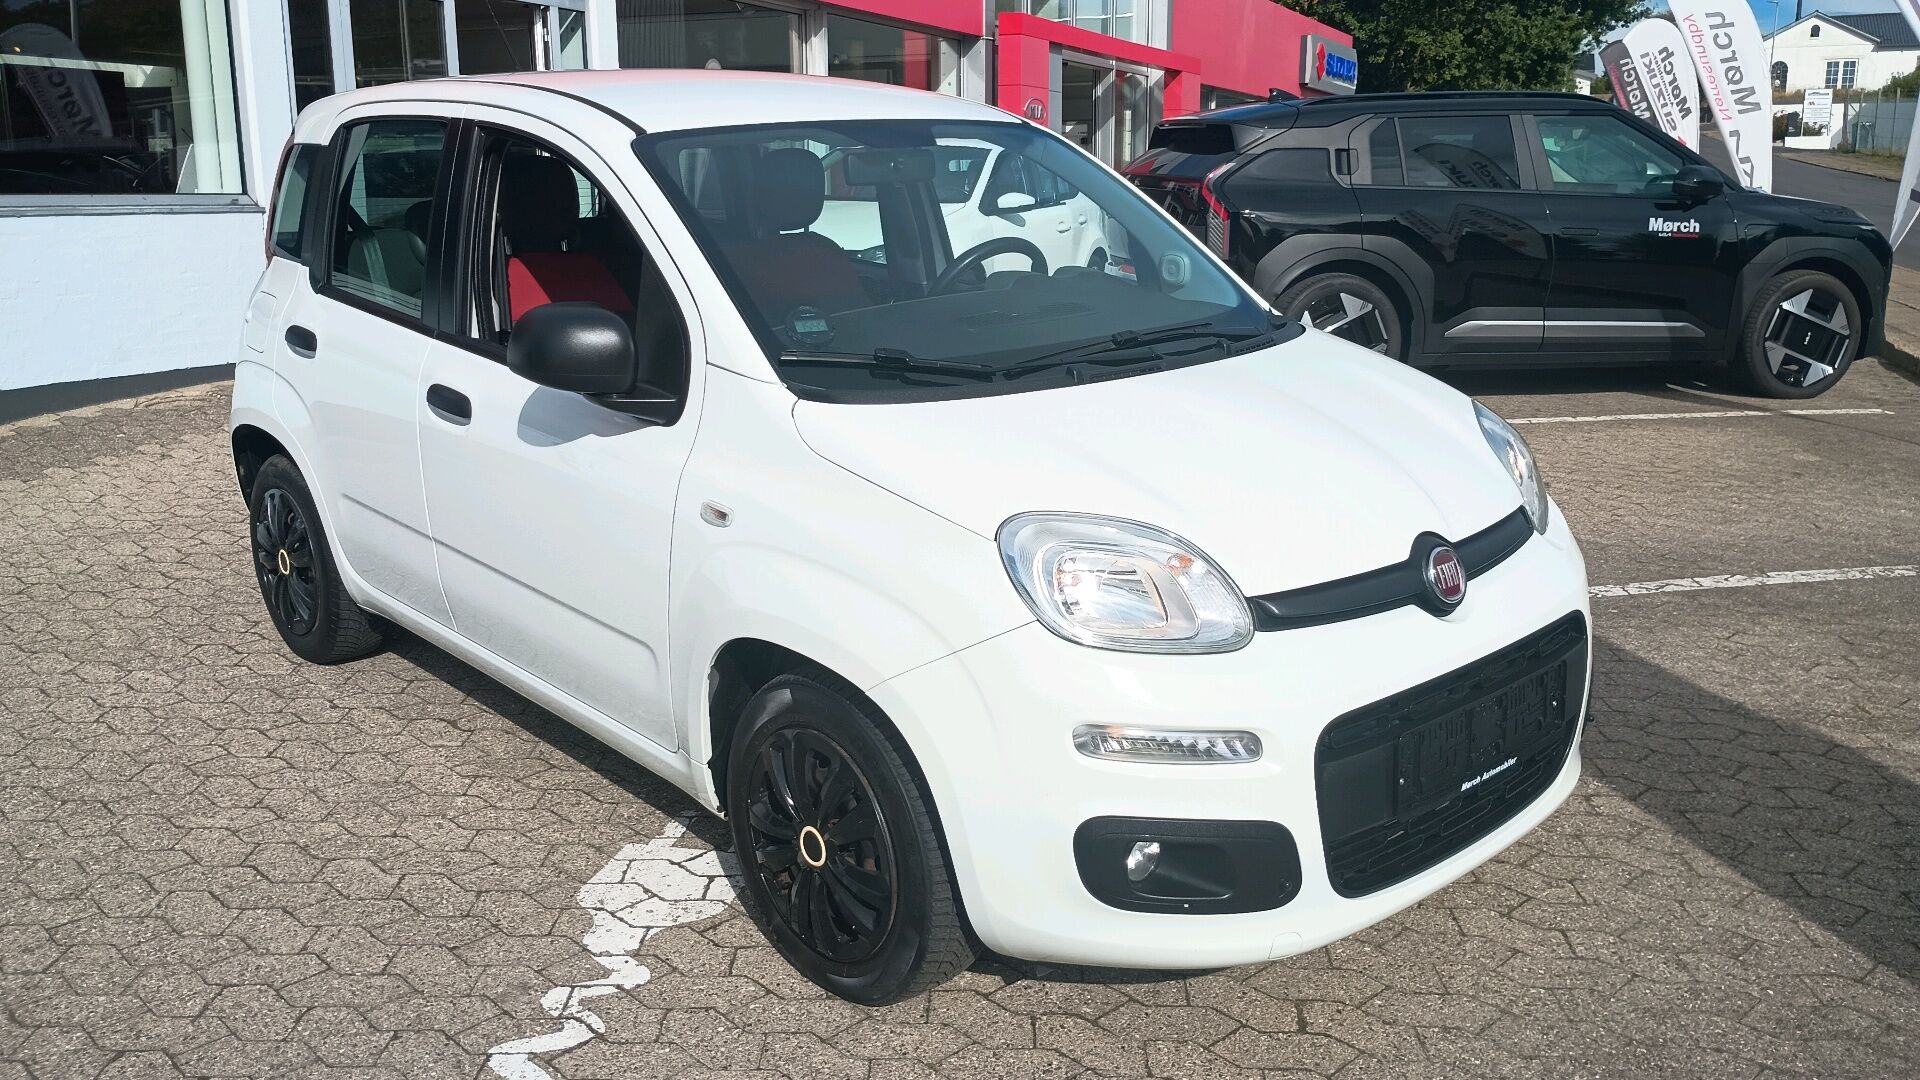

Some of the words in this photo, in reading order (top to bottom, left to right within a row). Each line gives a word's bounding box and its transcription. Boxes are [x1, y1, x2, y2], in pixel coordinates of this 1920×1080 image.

[1326, 52, 1357, 83] SUZUKI
[1648, 217, 1700, 233] Mørch
[1436, 560, 1460, 590] FIAT
